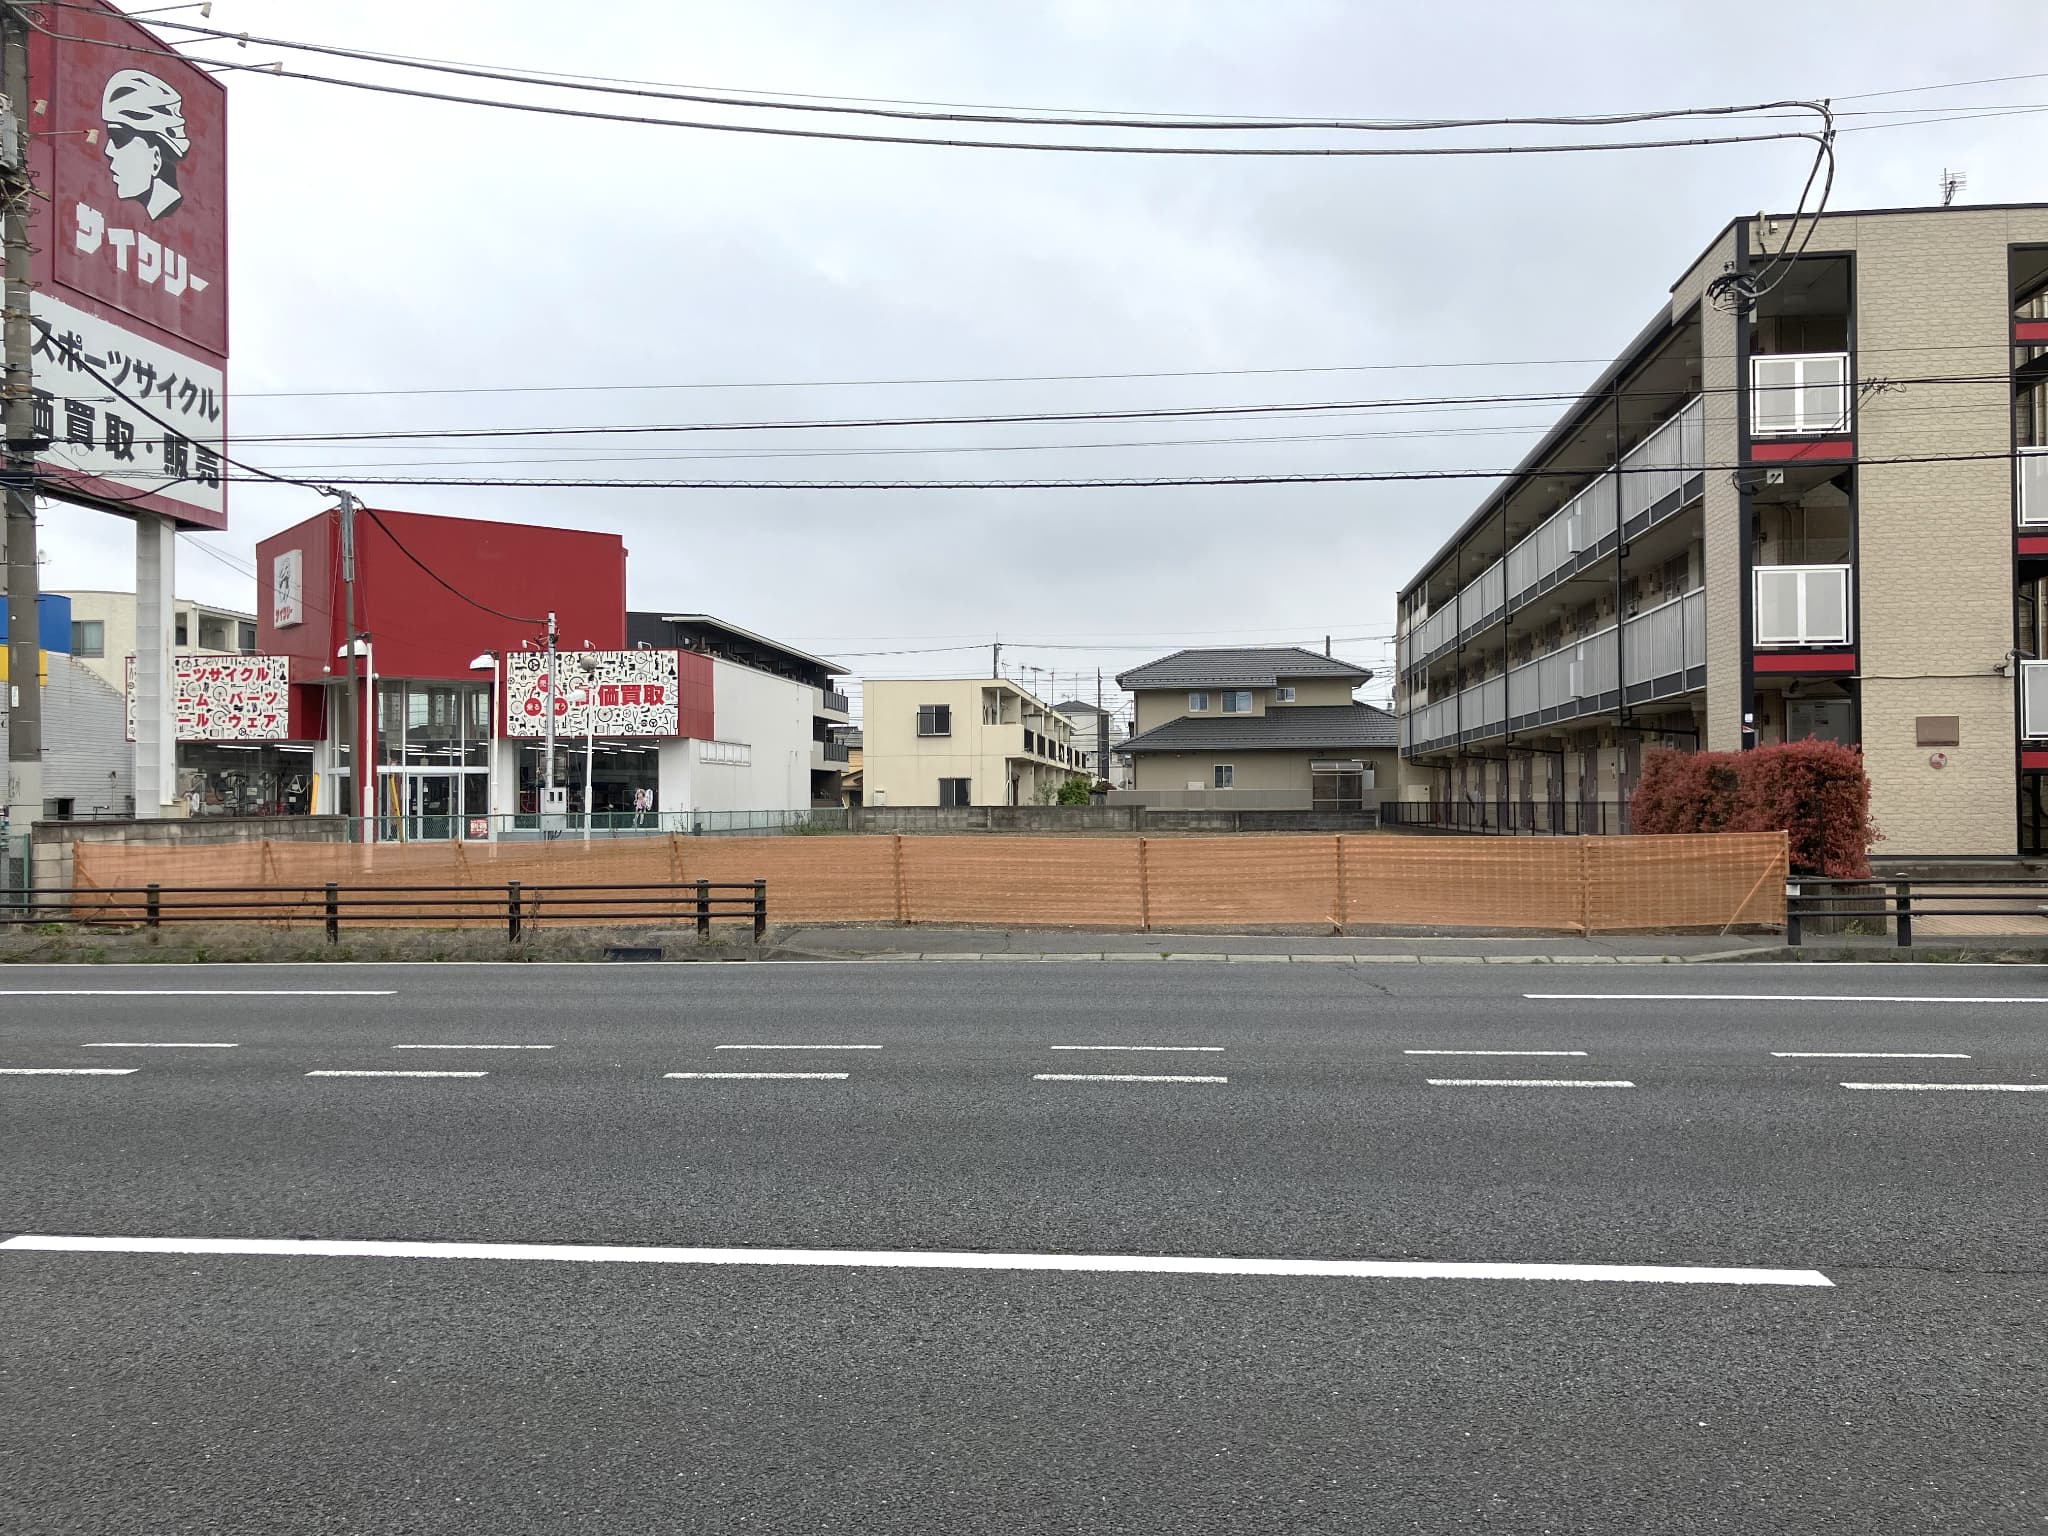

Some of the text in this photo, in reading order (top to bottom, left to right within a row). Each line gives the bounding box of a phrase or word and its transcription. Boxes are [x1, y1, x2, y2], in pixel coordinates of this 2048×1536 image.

[31, 317, 220, 423] スポーツサイクル
[0, 377, 219, 489] 価買取・販売
[177, 667, 269, 682] ーツサイクル
[178, 713, 277, 728] ール・ウェア
